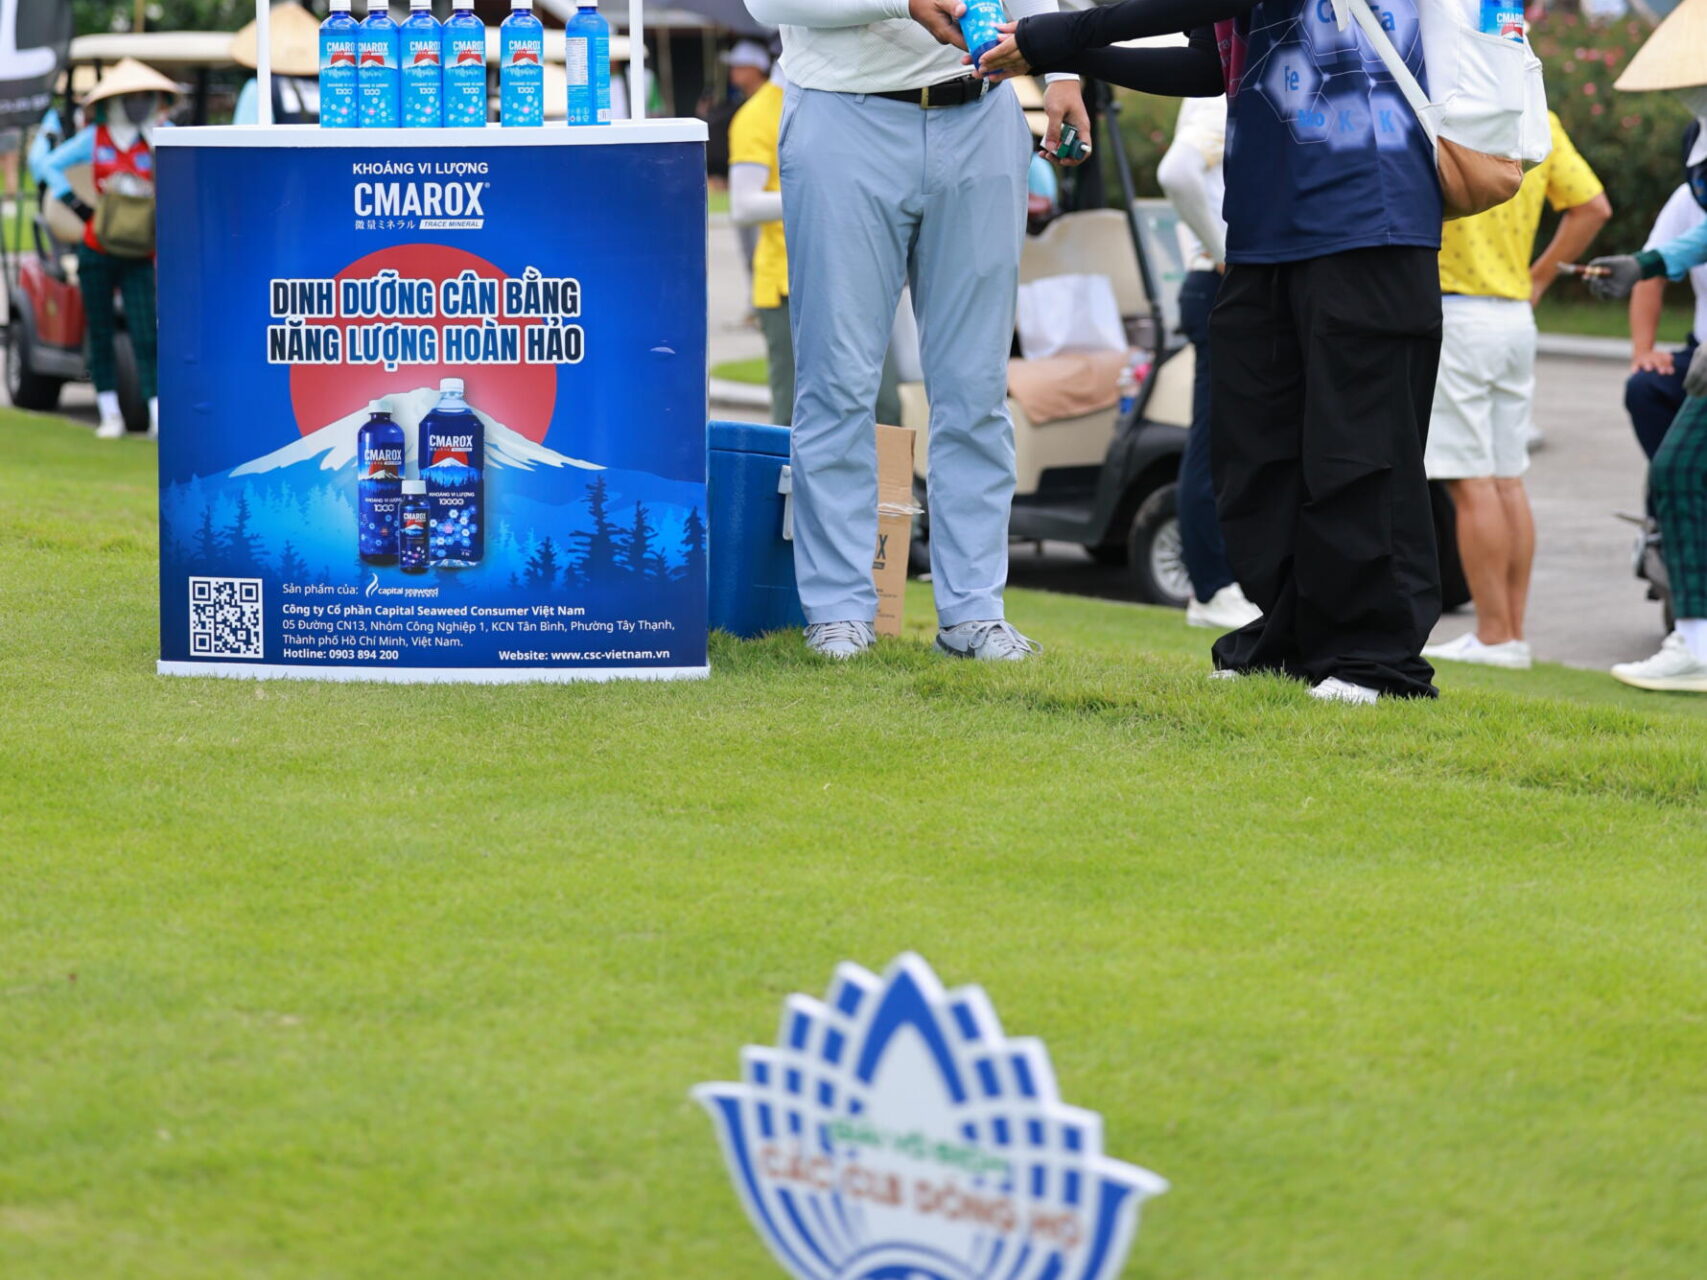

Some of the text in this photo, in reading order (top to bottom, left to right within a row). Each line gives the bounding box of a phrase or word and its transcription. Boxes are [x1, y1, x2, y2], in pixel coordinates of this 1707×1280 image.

[327, 41, 356, 52] CMARO
[353, 161, 489, 177] KHOÁNG VI LƯỢNG
[354, 182, 485, 216] CMAROX
[271, 267, 580, 317] DINH DƯỠNG CÂN BẰNG
[268, 317, 584, 371] NĂNG LƯỢNG HOÀN HẢO
[429, 435, 473, 447] CMAROX
[364, 449, 402, 461] CMAROX
[282, 583, 300, 595] Sản
[282, 604, 310, 618] Công
[313, 606, 324, 618] ty
[344, 605, 372, 618] phần
[375, 606, 414, 618] Capital
[417, 606, 467, 616] Seaweed
[470, 606, 528, 616] Consumer
[532, 606, 555, 618] Việt
[558, 606, 585, 616] Nam
[282, 621, 296, 630] 05
[298, 620, 334, 632] Đường
[336, 621, 368, 632] CN13,
[370, 621, 402, 632] Nhóm
[406, 621, 434, 633] Công
[437, 622, 476, 634] Nghiệp
[480, 622, 489, 632] 1,
[492, 622, 514, 632] KCN
[516, 622, 537, 632] Tân
[570, 621, 614, 634] Phường
[616, 620, 636, 634] Tây
[638, 620, 675, 632] Thạnh,
[282, 634, 316, 645] Thành
[318, 634, 339, 647] phố
[359, 635, 376, 646] Chí
[379, 636, 408, 647] Minh,
[411, 636, 432, 648] Việt
[434, 637, 464, 647] Nam.
[283, 648, 399, 660] Hotline: 0903 894 200
[498, 649, 670, 660] Website: www.csc-vietnam.vn
